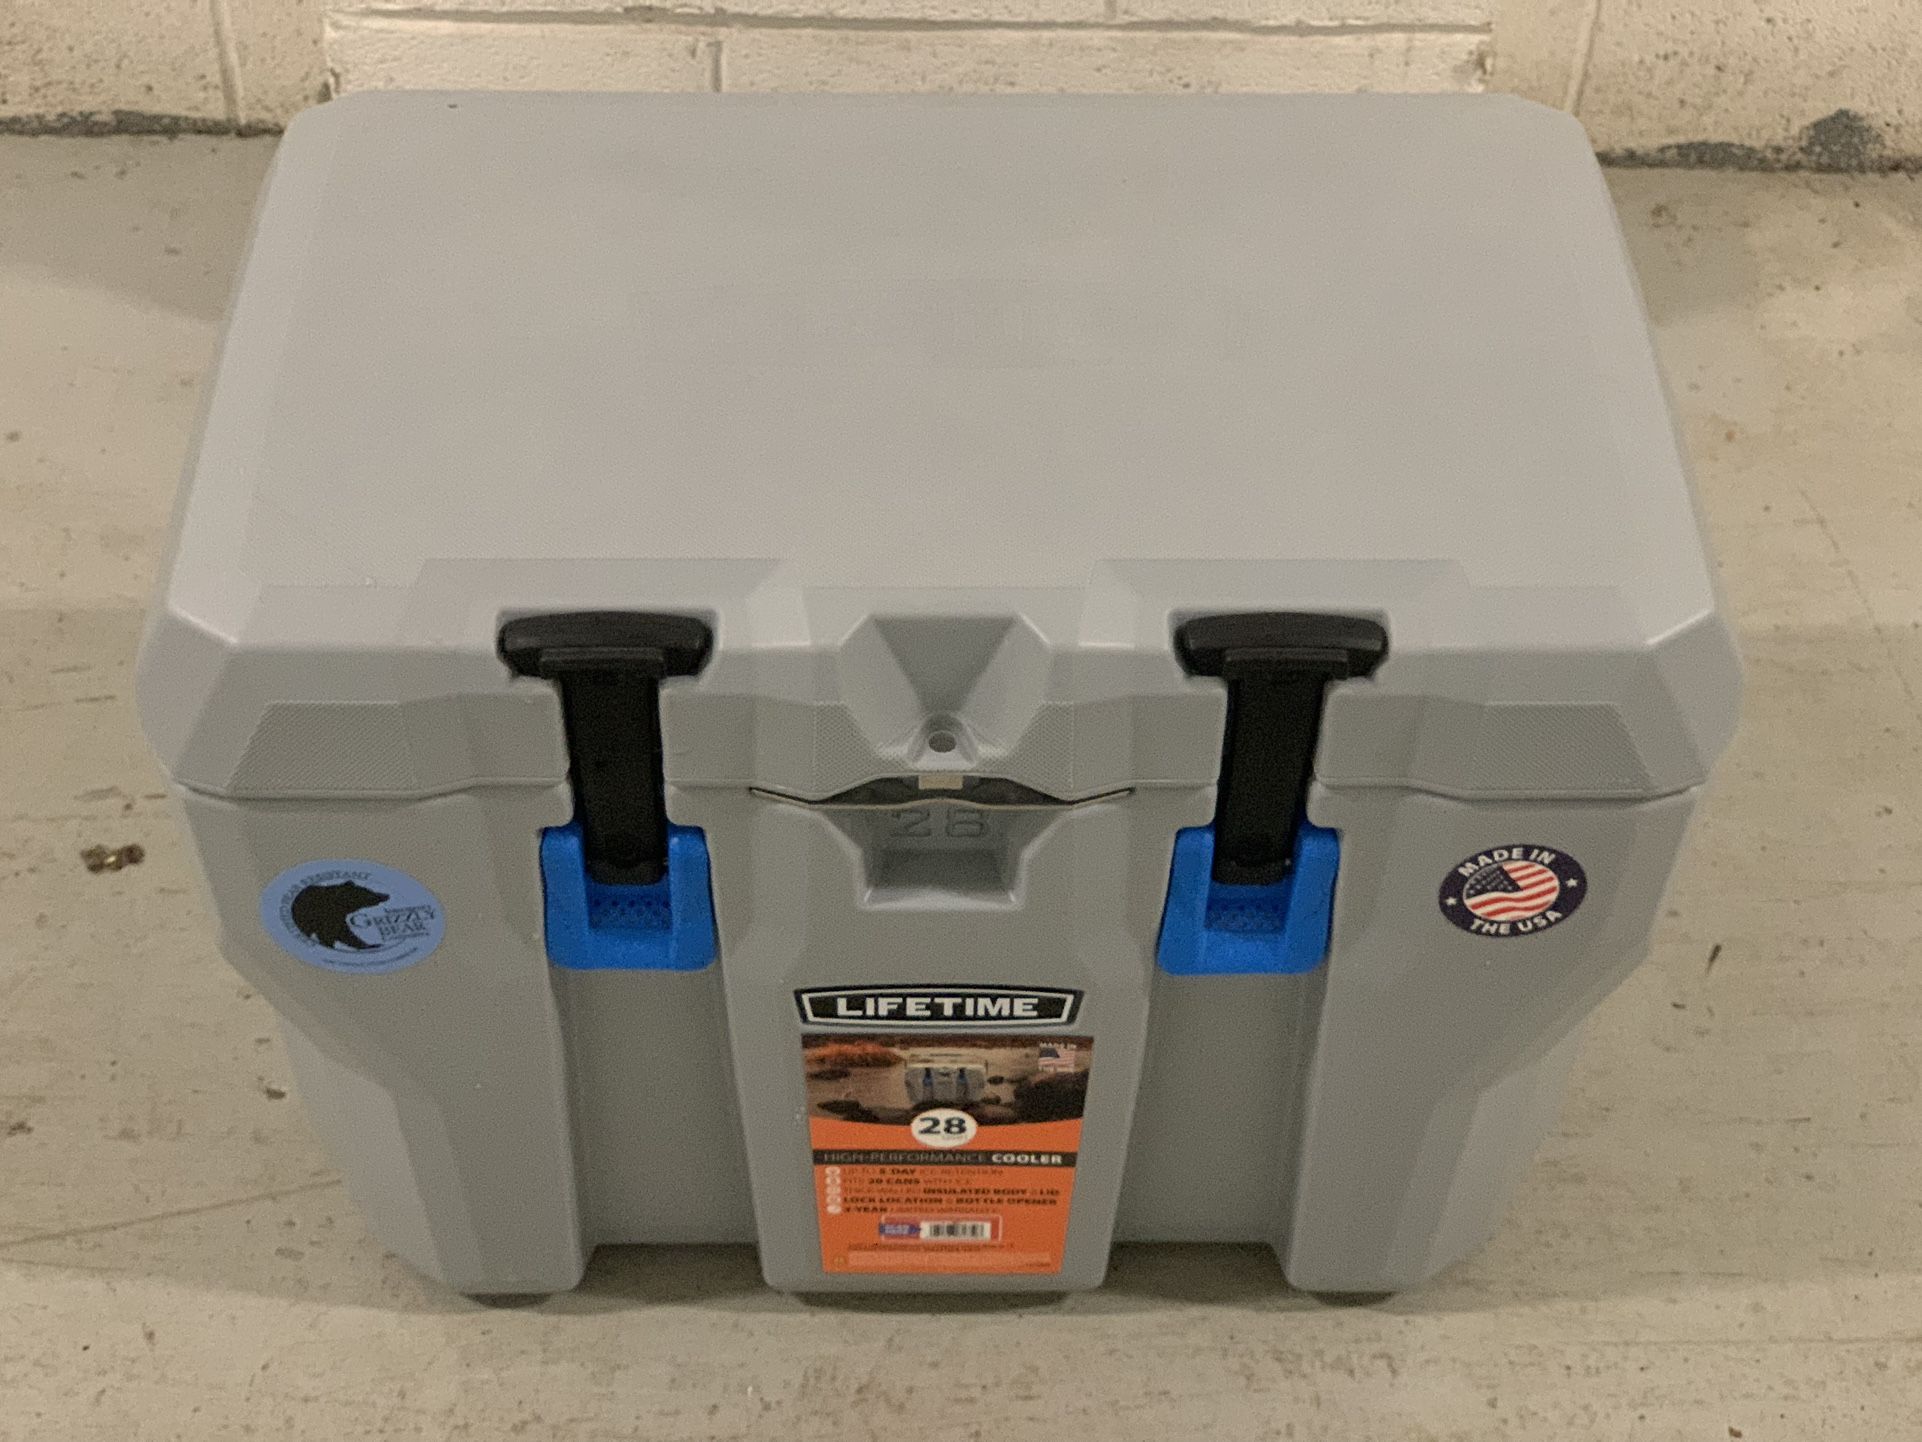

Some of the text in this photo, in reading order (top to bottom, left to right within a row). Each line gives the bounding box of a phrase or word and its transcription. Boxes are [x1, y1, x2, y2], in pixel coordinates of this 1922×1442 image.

[891, 808, 986, 838] 28
[1458, 847, 1556, 877] MADE IN
[1469, 910, 1563, 935] THE USA
[836, 997, 1039, 1017] LIFETIME
[919, 1117, 967, 1135] 28
[824, 1152, 1063, 1164] HIGH-PERFORMANCE COOLER
